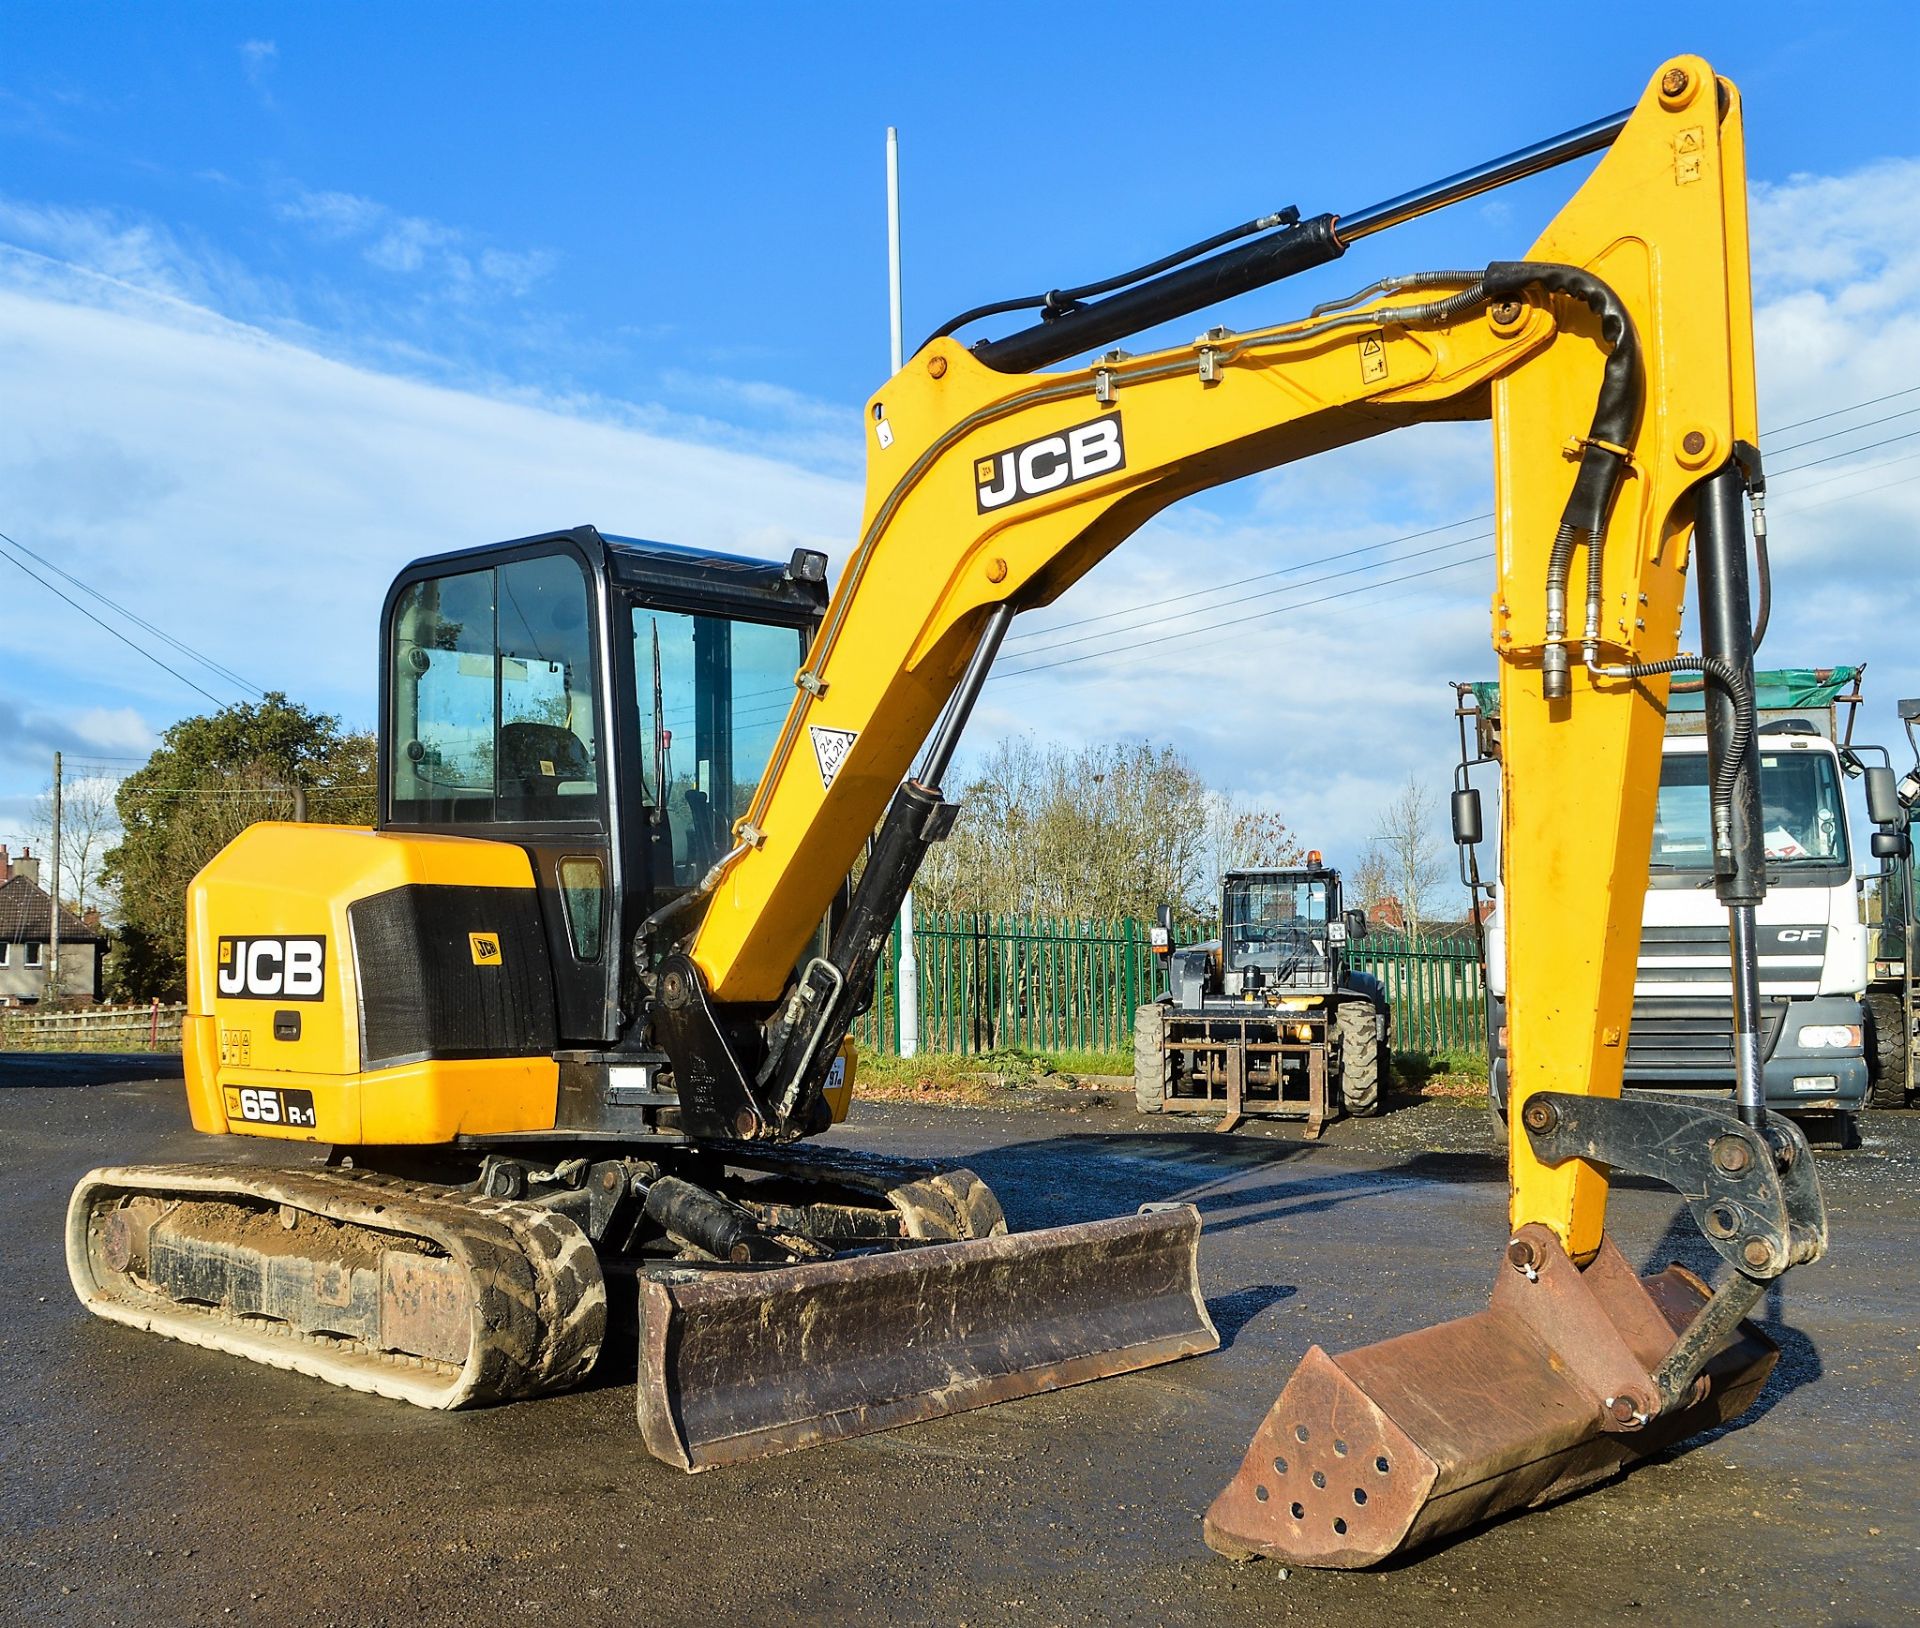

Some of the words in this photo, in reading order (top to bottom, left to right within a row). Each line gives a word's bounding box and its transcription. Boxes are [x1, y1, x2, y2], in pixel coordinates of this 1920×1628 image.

[979, 420, 1122, 508] JCB
[820, 736, 832, 755] 24
[477, 941, 496, 957] JCB
[1778, 930, 1823, 943] CF
[218, 939, 324, 996] JCB
[241, 1088, 280, 1122] 65
[288, 1106, 315, 1125] R-1
